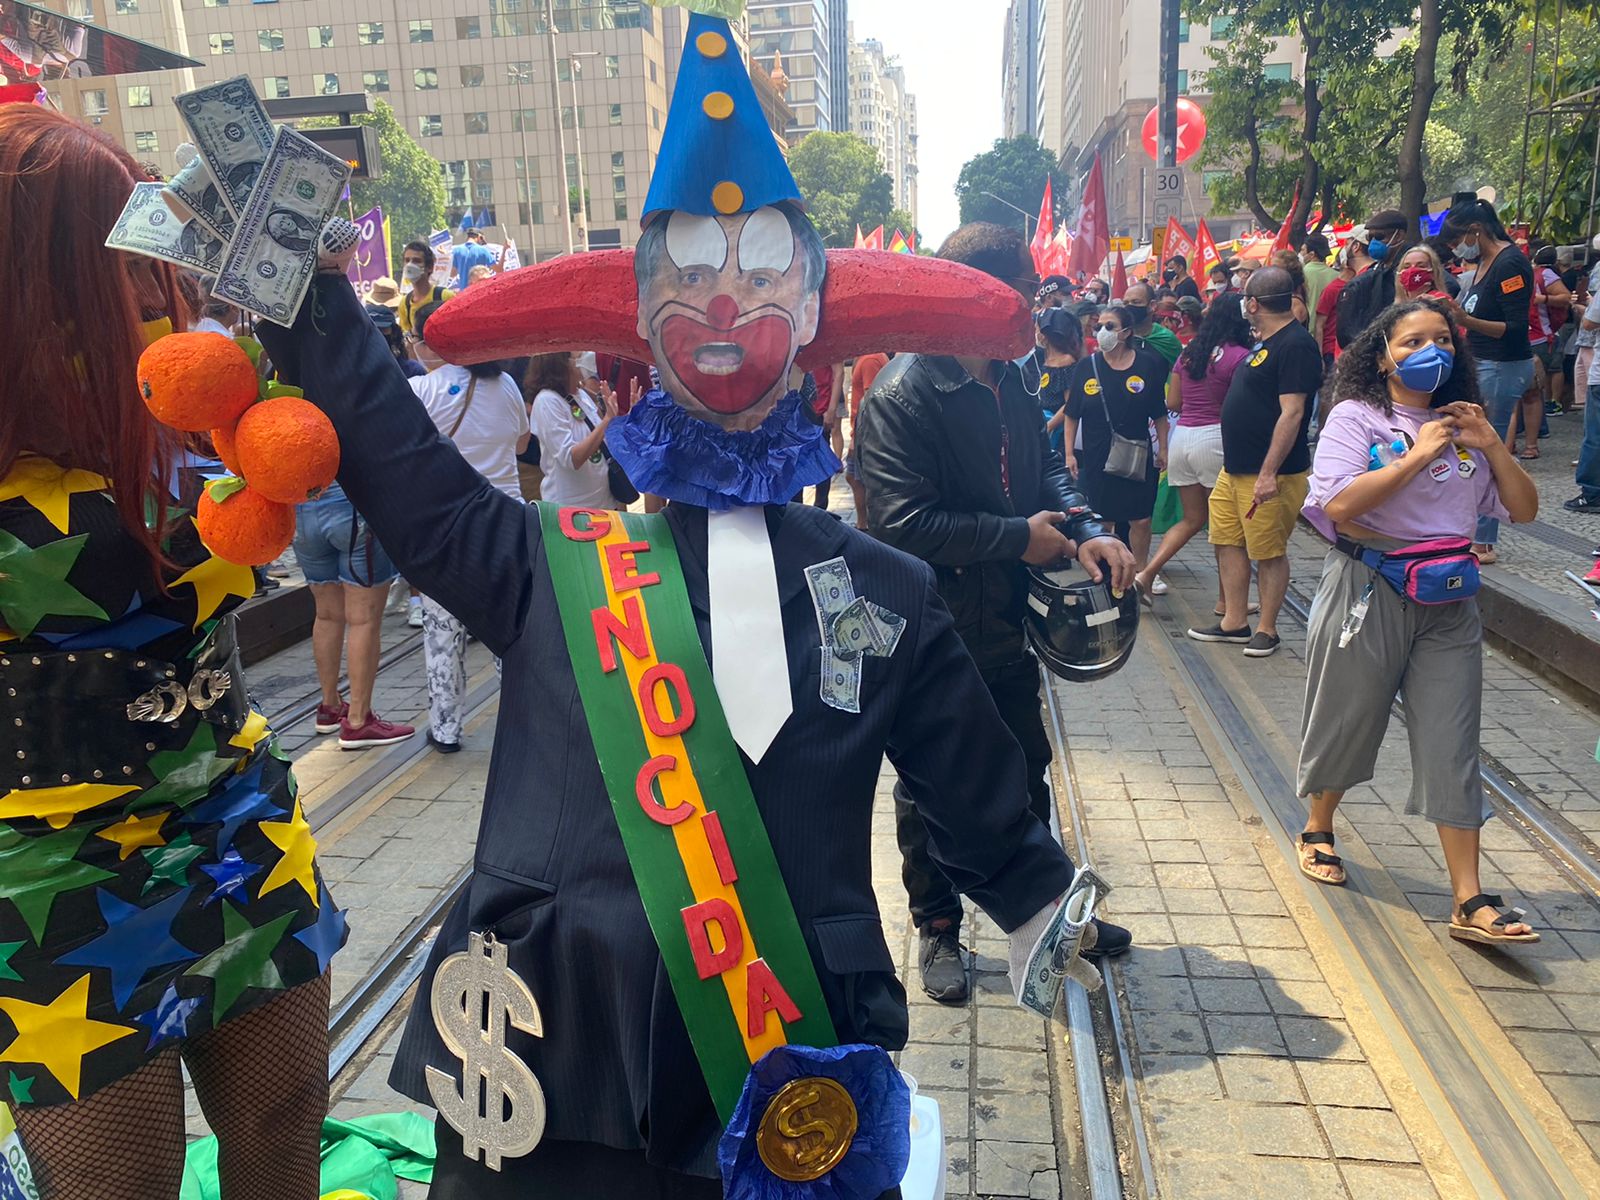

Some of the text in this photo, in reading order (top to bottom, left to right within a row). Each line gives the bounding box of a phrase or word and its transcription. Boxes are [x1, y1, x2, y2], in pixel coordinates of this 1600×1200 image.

[1157, 174, 1179, 191] 30
[222, 182, 244, 218] DOLLA
[232, 158, 284, 272] THE UNITED STATES OF AMERICA
[199, 210, 233, 241] DOLLA
[183, 256, 220, 273] DOLLA
[557, 506, 804, 1040] GENOCIDA
